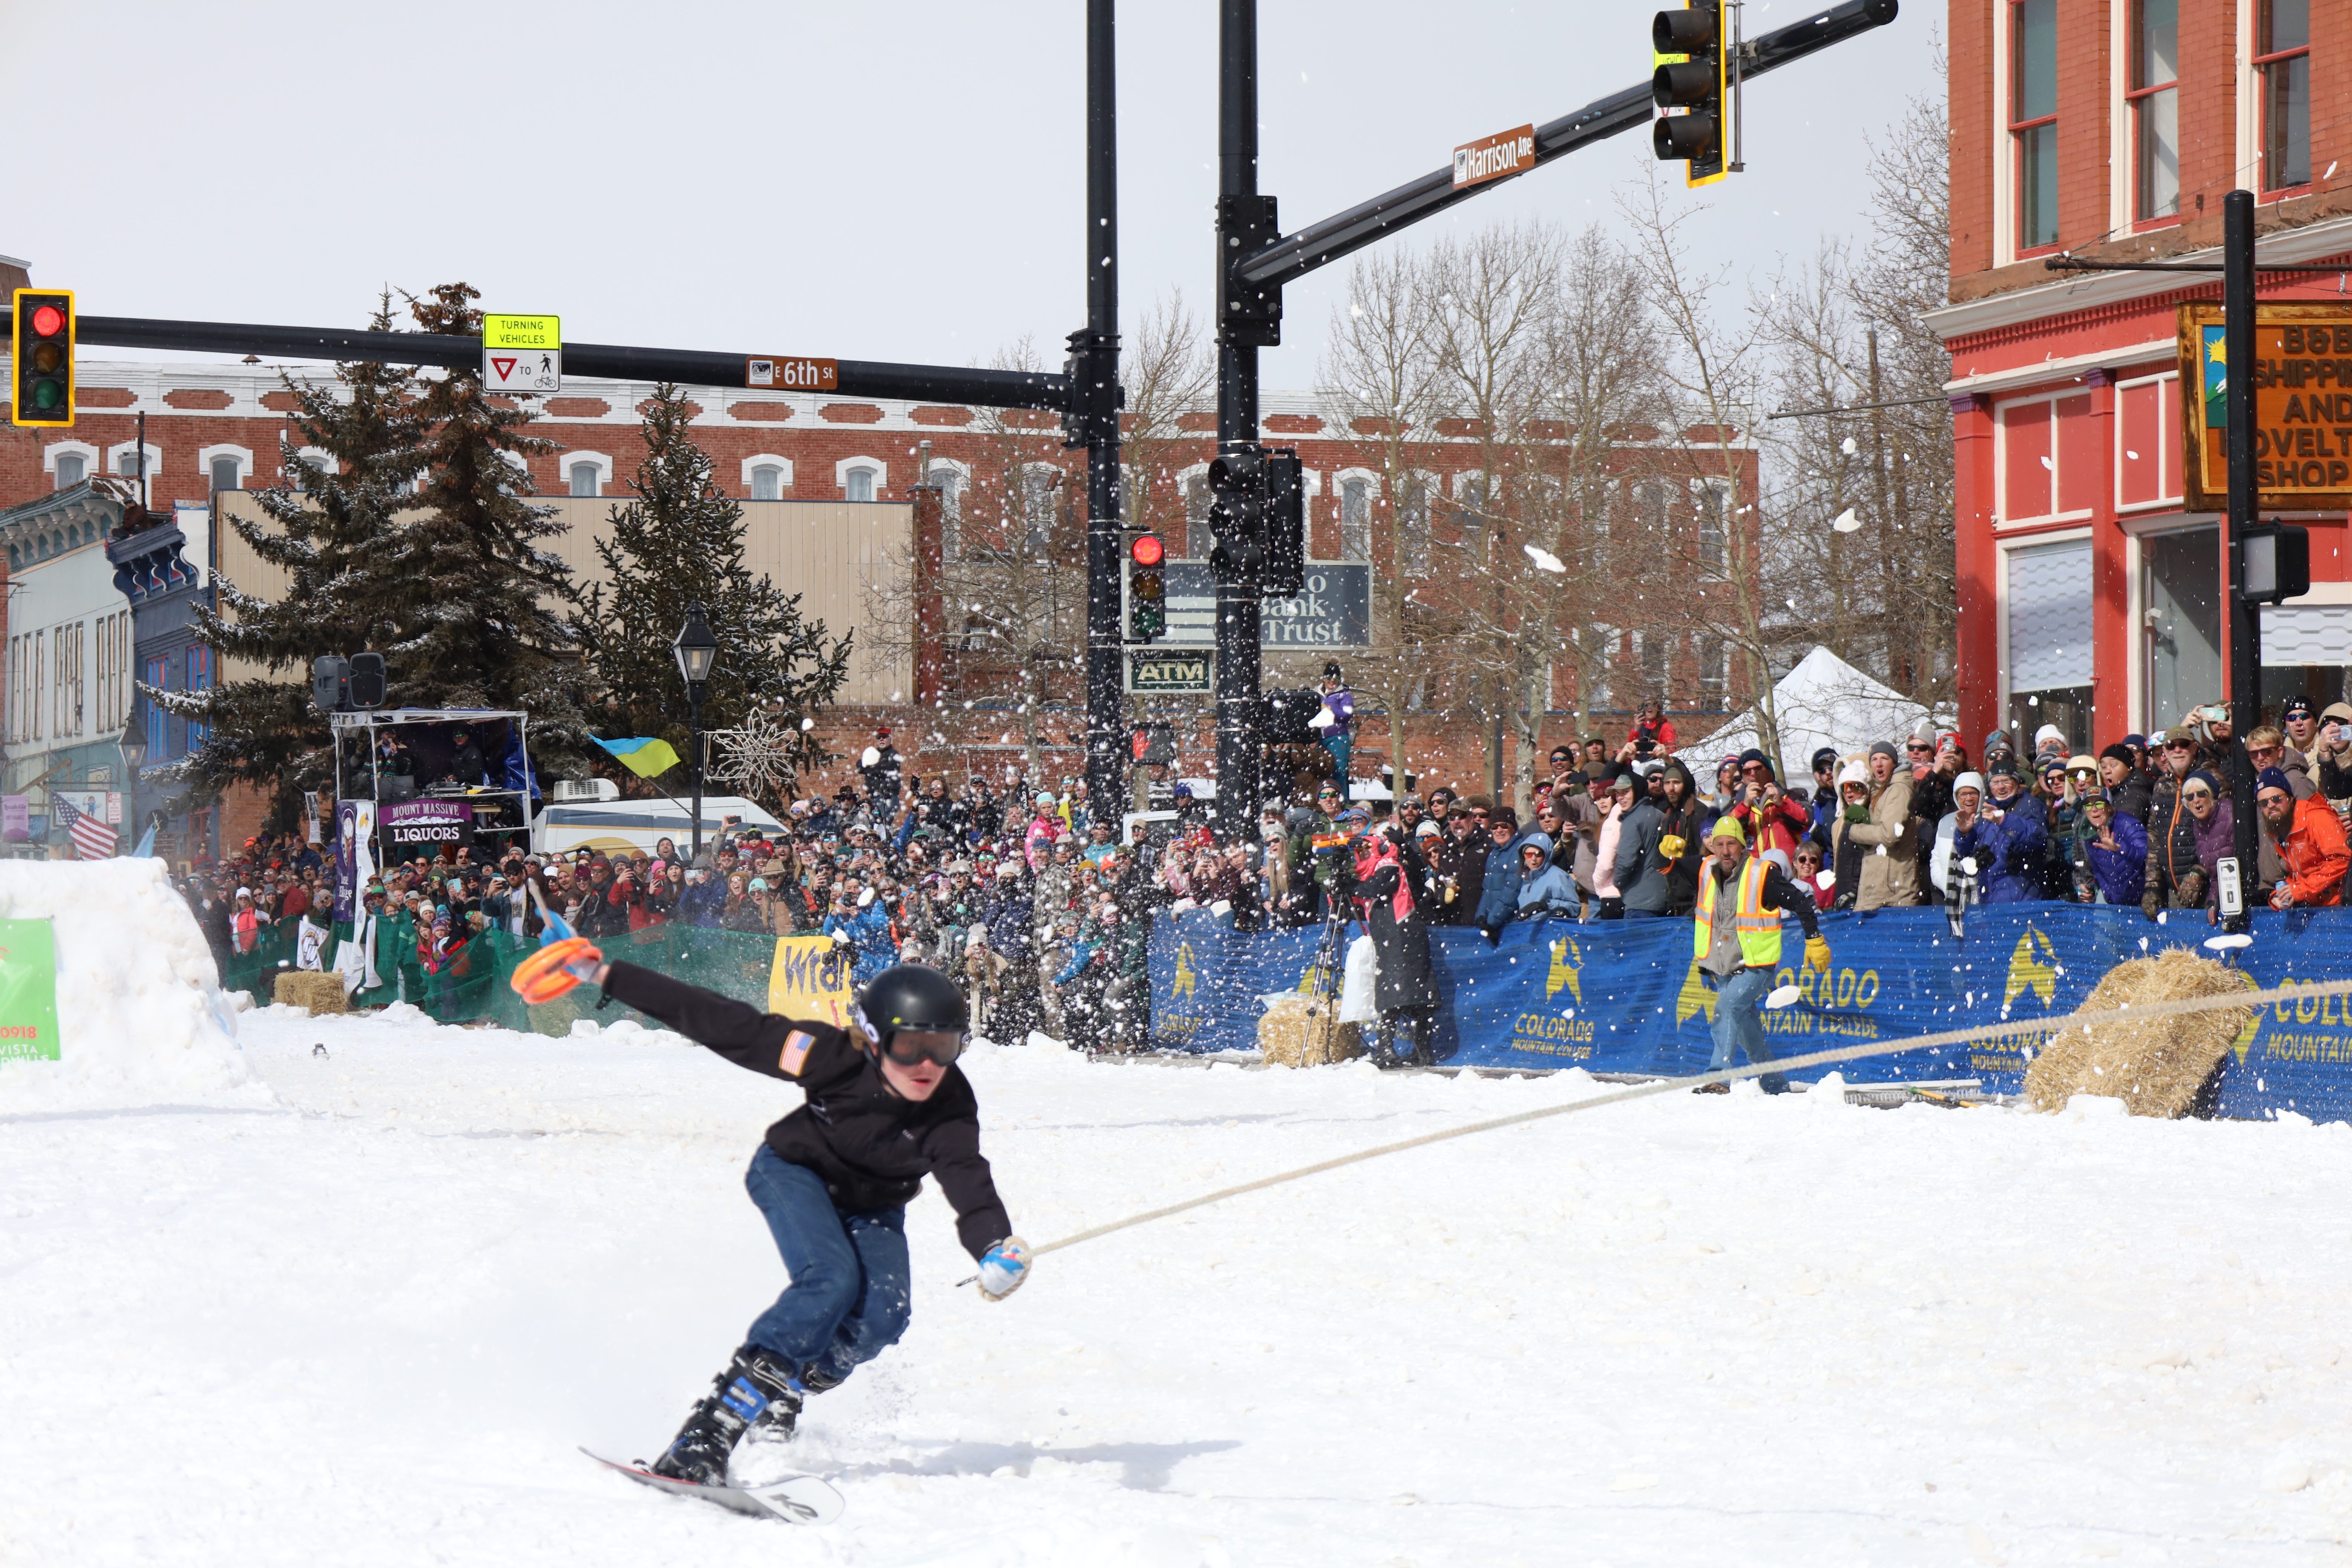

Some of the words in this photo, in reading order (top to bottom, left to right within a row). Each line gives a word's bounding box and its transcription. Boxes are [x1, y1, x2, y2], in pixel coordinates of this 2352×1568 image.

[1468, 138, 1519, 179] Harrison
[1517, 136, 1532, 158] Ave
[501, 320, 544, 329] TURNING
[499, 334, 545, 343] VEHICLES
[2283, 325, 2352, 355] B&B
[519, 366, 531, 375] TO
[775, 366, 780, 378] E
[784, 360, 818, 385] 6th
[823, 367, 833, 378] St
[2283, 394, 2352, 423] AND
[2257, 460, 2349, 487] SHOP
[1261, 619, 1341, 642] Trust
[1137, 663, 1203, 680] ATM
[392, 804, 420, 818] MOUNT
[423, 803, 459, 816] MASSIVE
[394, 827, 459, 842] LIQUORS
[784, 945, 850, 997] Wran
[1772, 967, 1879, 1009] ORADO
[1514, 1013, 1594, 1042] COLORADO
[1759, 1011, 1812, 1034] NTAIN
[0, 1044, 38, 1055] VISTA
[1511, 1037, 1556, 1054] MOUNTAIN
[1556, 1044, 1592, 1059] COLLEGE
